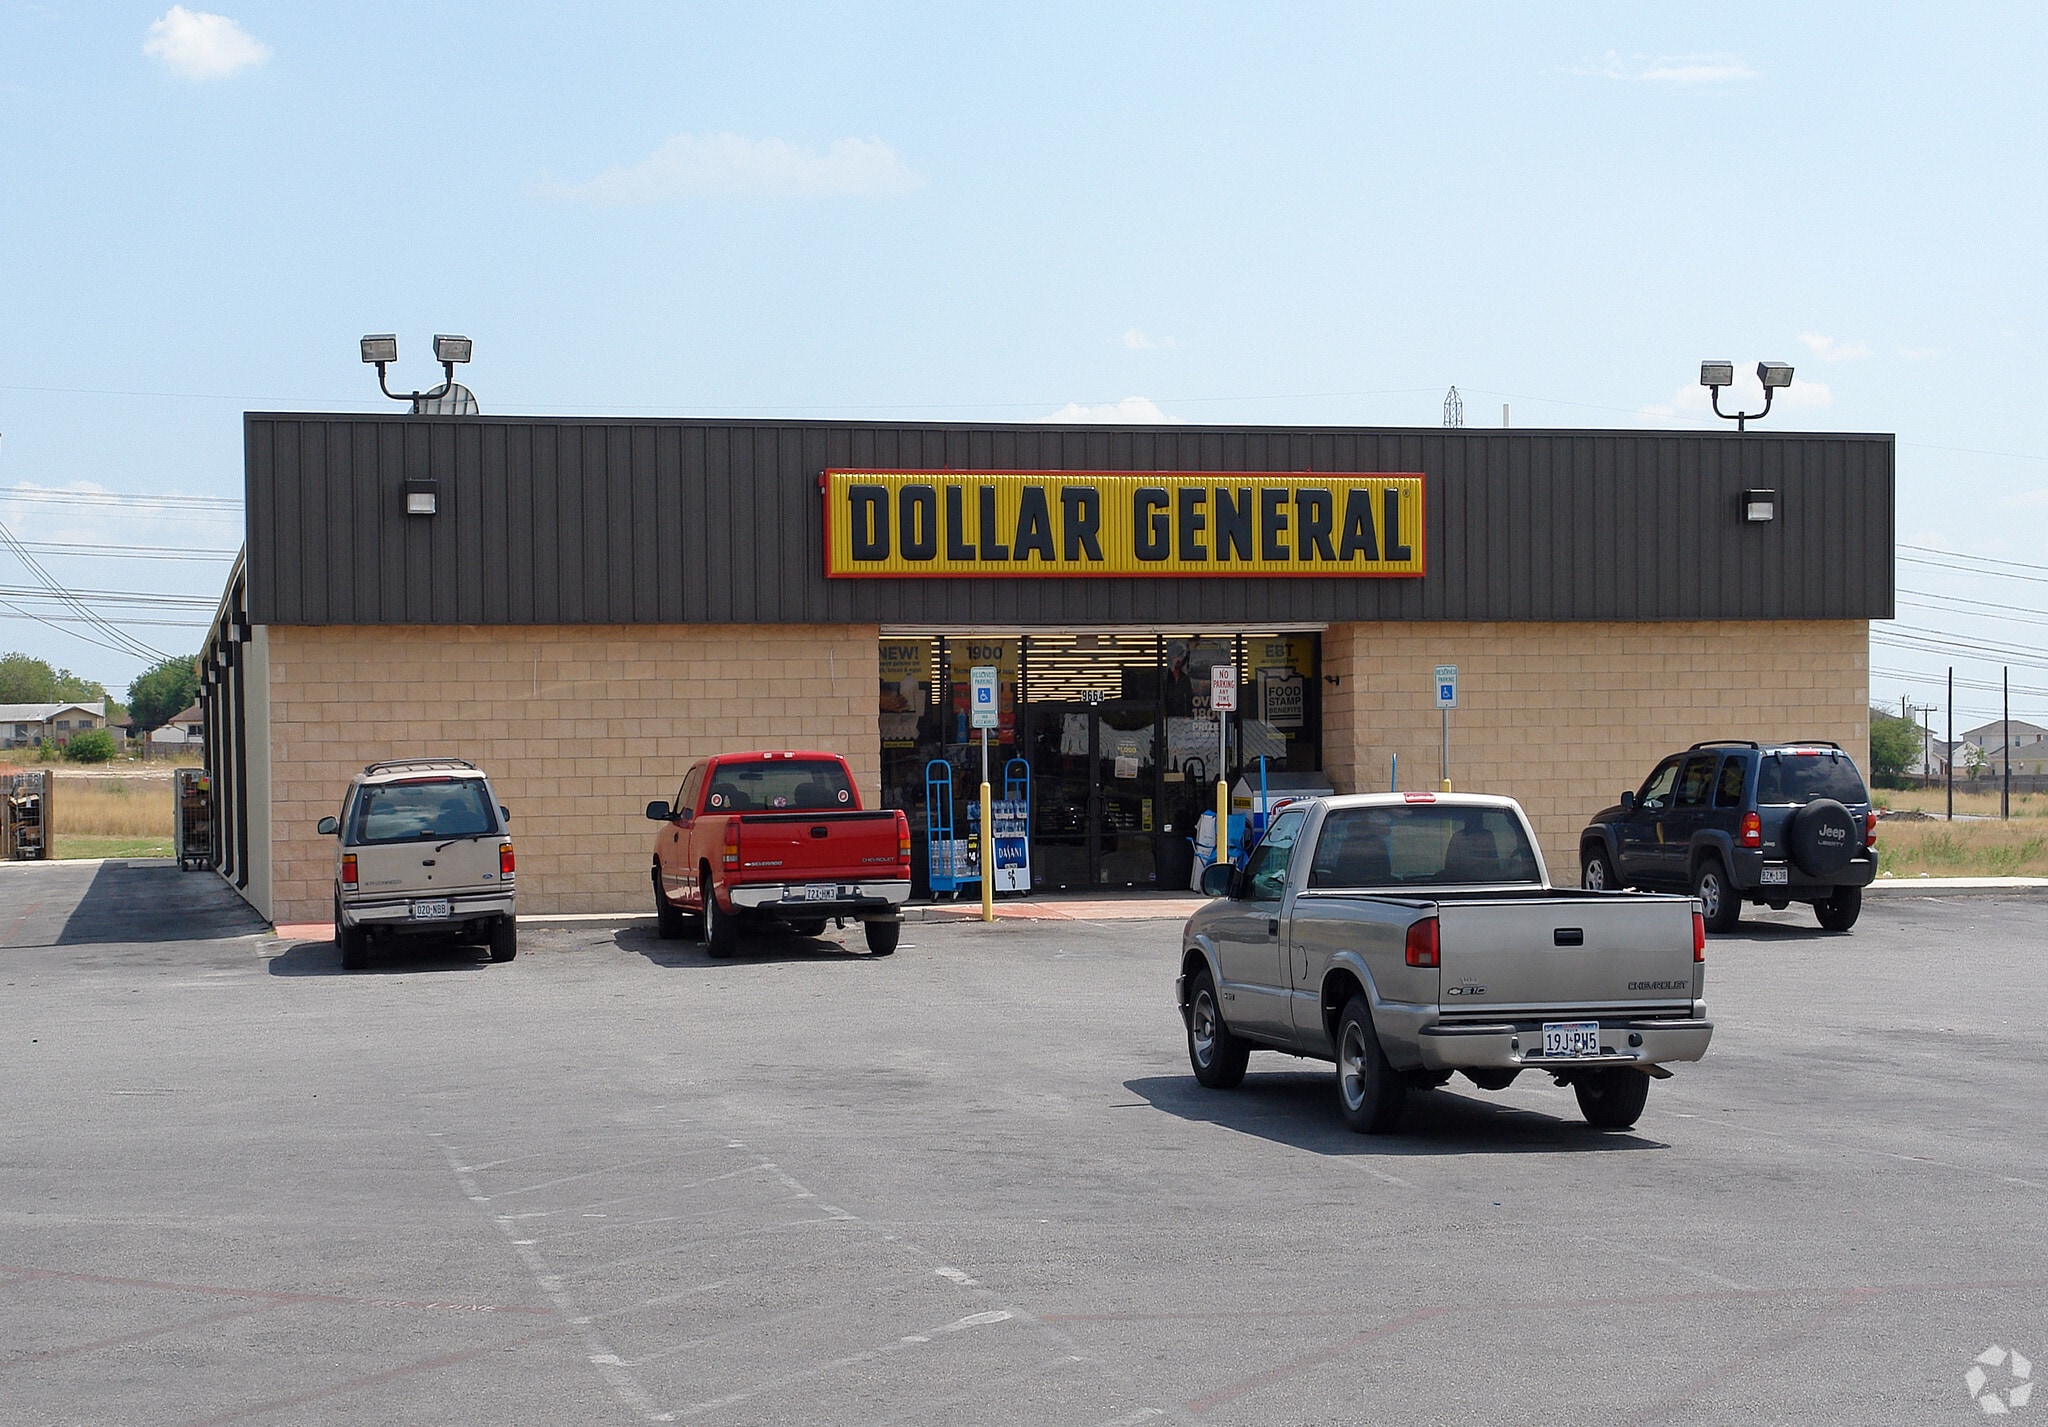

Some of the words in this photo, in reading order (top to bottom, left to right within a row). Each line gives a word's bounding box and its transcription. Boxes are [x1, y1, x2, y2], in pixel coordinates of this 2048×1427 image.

[848, 484, 1104, 562] DOLLAR
[1133, 486, 1411, 562] GENERAL
[966, 645, 1003, 660] 1900
[1265, 643, 1294, 658] EBT
[1219, 670, 1229, 679] NO
[1213, 680, 1235, 689] PARKING
[1081, 689, 1104, 701] 9664
[1268, 686, 1301, 697] FOOD
[1268, 696, 1302, 706] STAMP
[1268, 706, 1302, 714] BENEFITS
[1819, 824, 1845, 840] Jeep
[998, 844, 1022, 860] DASANI
[1461, 986, 1487, 995] S10
[1627, 979, 1689, 991] CHEVROLET
